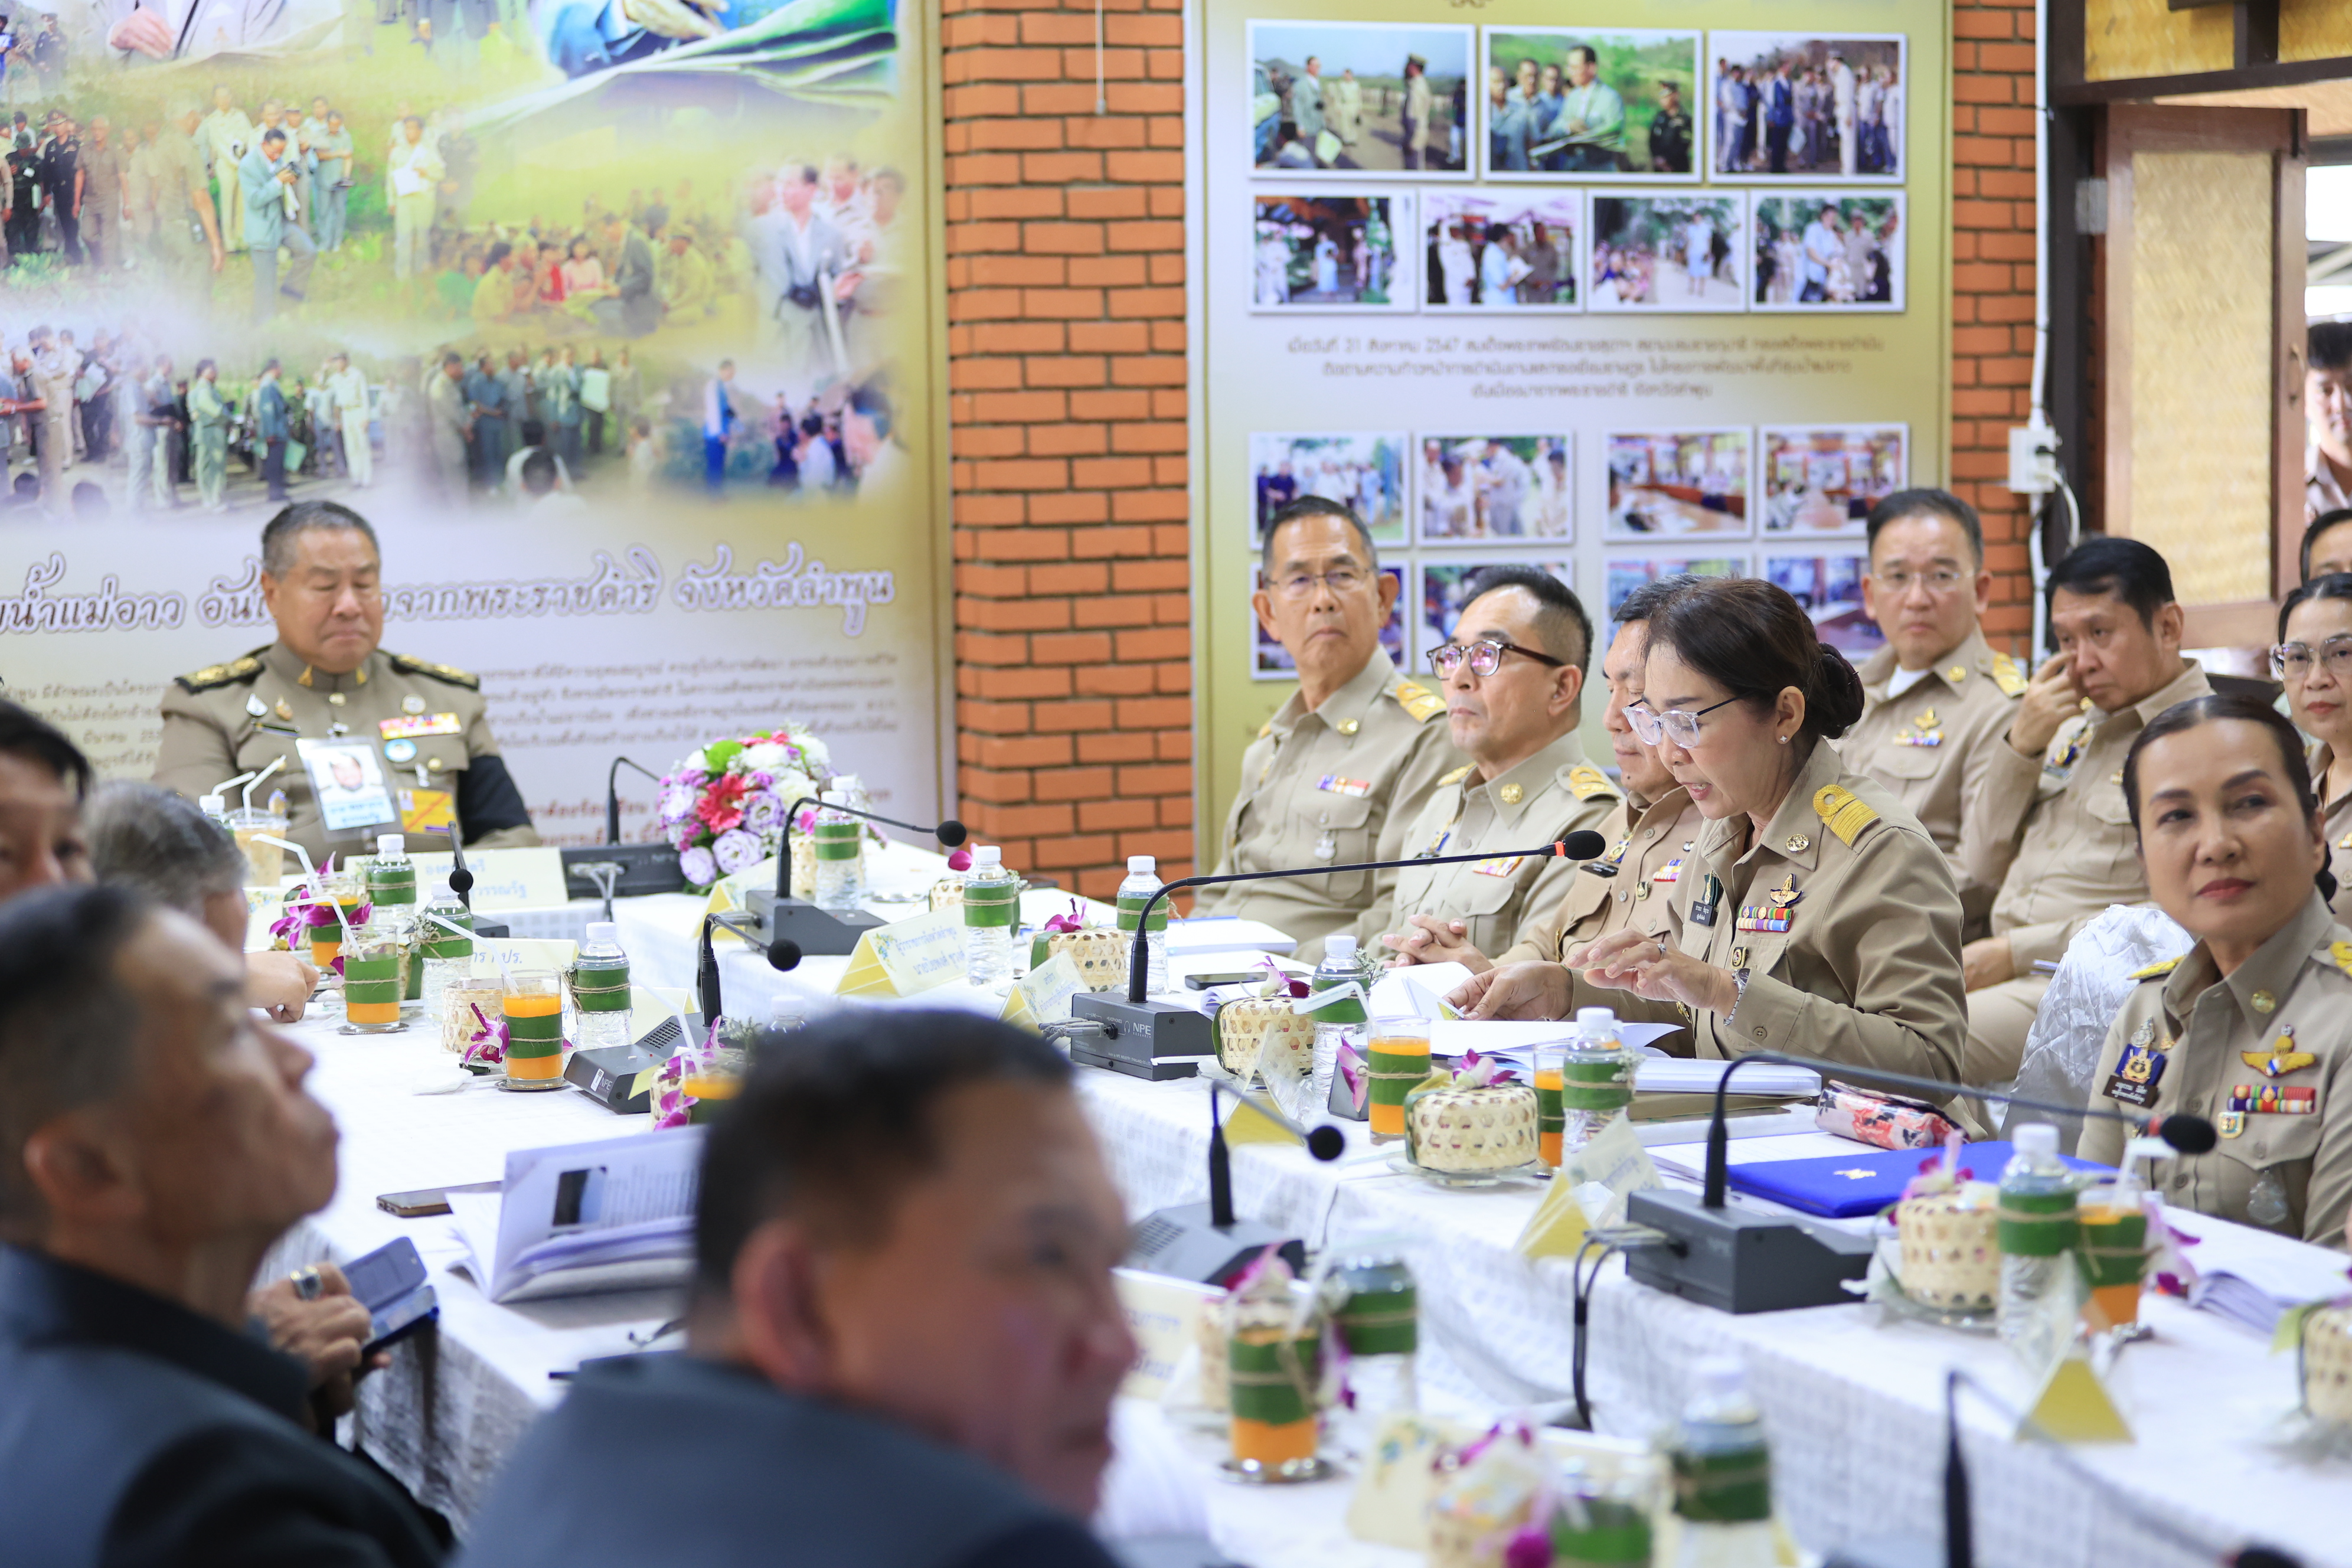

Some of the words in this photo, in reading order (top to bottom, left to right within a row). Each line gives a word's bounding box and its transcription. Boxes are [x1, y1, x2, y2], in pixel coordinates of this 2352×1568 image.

[675, 540, 896, 636] จังหวัดลำพูน
[1133, 1022, 1152, 1035] NPE
[599, 1077, 613, 1090] NPE
